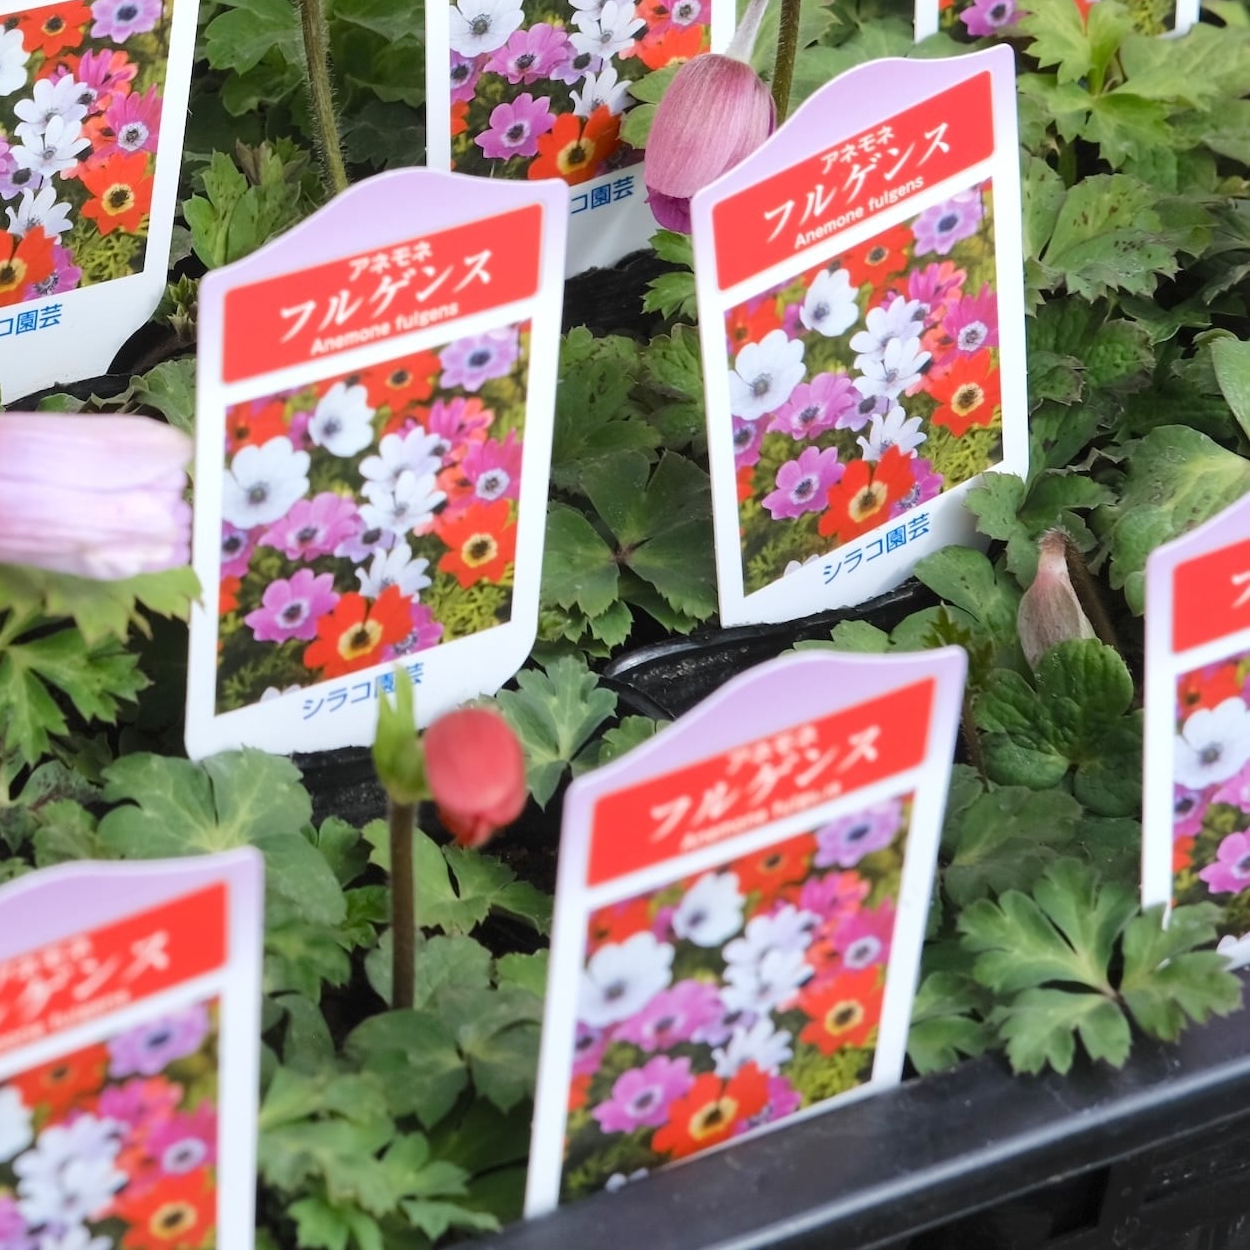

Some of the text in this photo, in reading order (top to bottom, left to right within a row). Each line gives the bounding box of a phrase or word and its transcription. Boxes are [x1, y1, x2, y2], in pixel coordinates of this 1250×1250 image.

[764, 121, 950, 243] フルゲンス
[820, 125, 895, 175] アネモネ
[570, 175, 635, 215] コ園芸
[794, 175, 925, 250] Anemone fulgens
[280, 249, 492, 343] フルゲンス
[349, 240, 432, 282] アネモネ
[310, 302, 459, 356] Anemone fulgens
[823, 512, 930, 585] シラコ園芸
[650, 727, 880, 842] フルゲンス
